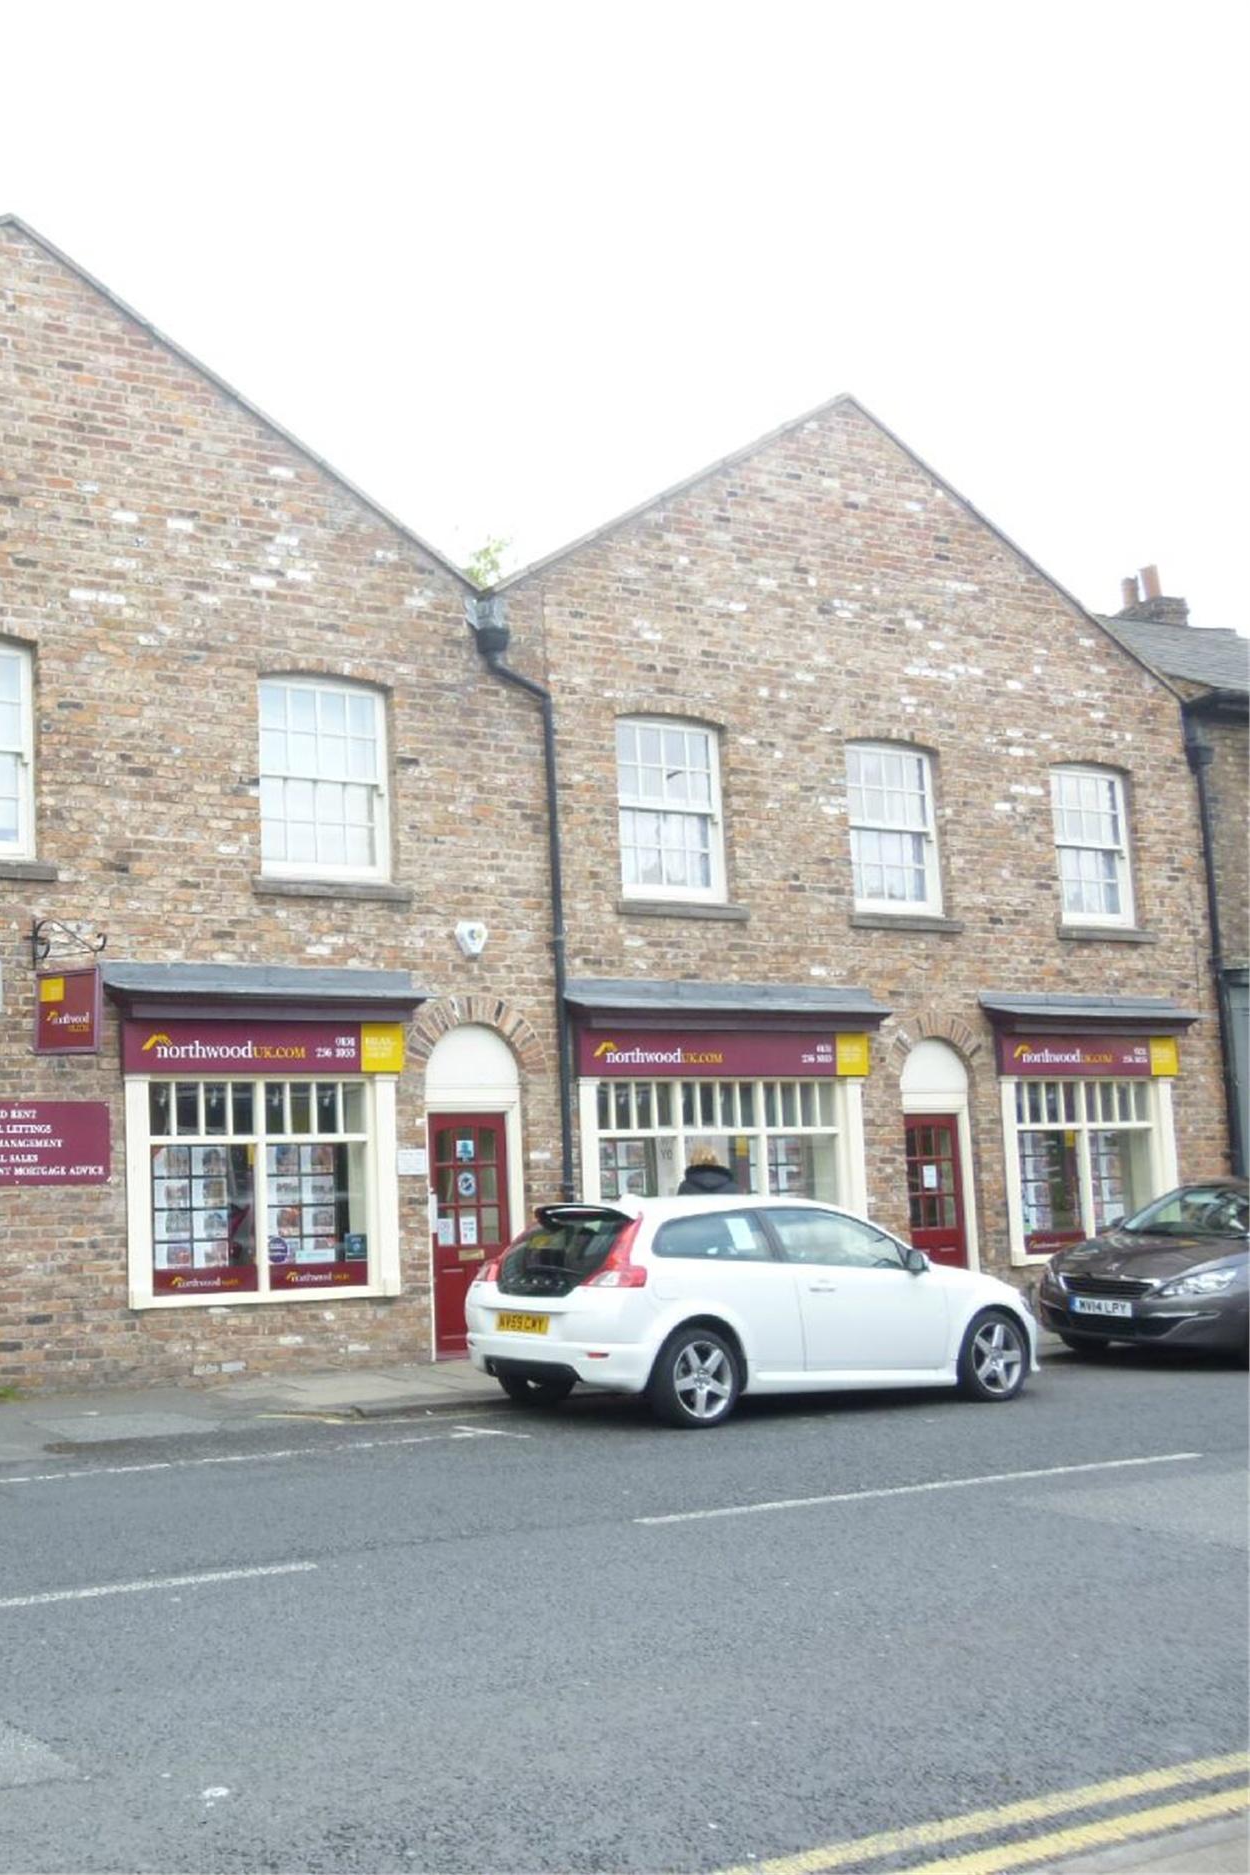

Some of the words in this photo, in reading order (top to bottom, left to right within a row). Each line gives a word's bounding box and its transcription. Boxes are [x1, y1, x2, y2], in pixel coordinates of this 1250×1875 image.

[10, 1109, 37, 1119] RENT
[6, 1124, 51, 1134] LETTINGS
[9, 1154, 39, 1163] SALES
[13, 1165, 67, 1176] MORTGAGE
[69, 1165, 104, 1176] ADVICE
[1104, 1301, 1126, 1315] LPY
